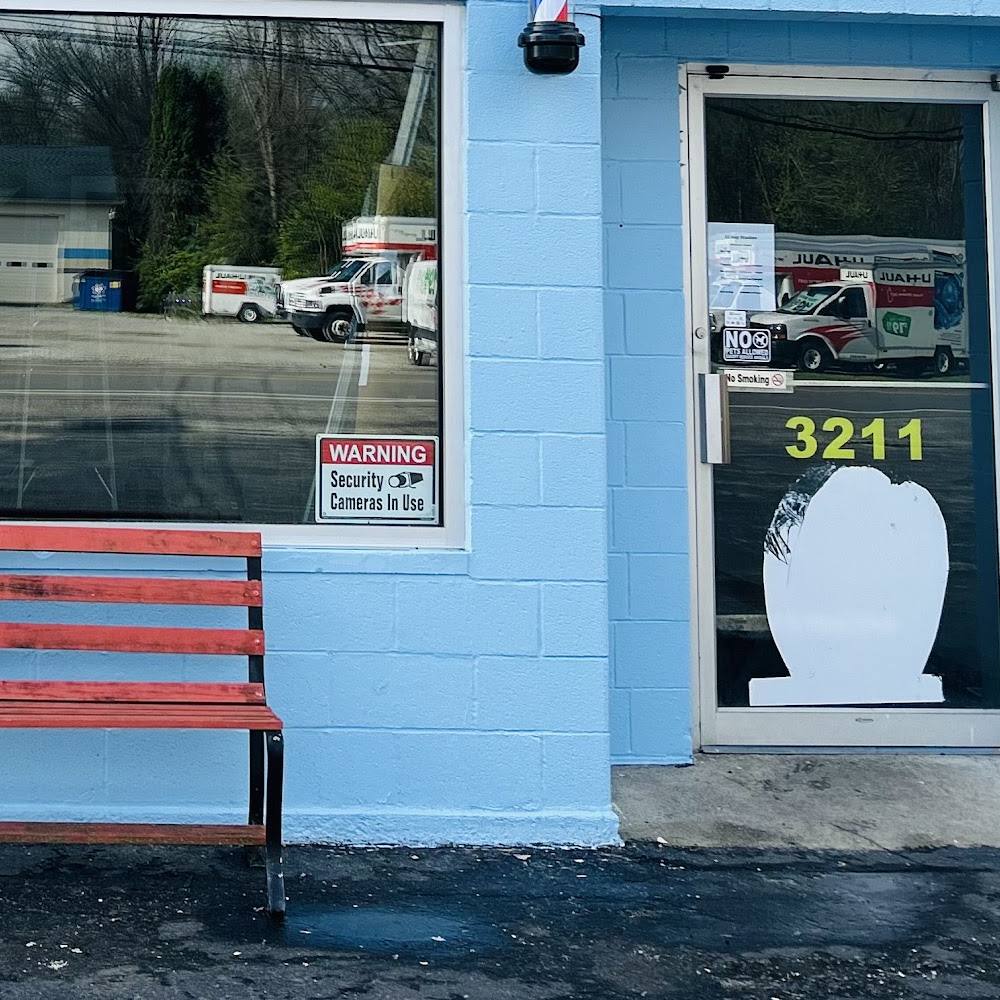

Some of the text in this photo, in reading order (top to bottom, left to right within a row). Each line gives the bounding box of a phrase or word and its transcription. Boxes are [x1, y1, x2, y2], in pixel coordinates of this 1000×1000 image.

[725, 330, 752, 348] NO
[726, 373, 770, 386] No Smoking
[785, 416, 923, 461] 3211
[329, 443, 427, 463] WARNING
[330, 470, 384, 492] Security
[330, 492, 424, 511] Cameras In Use
